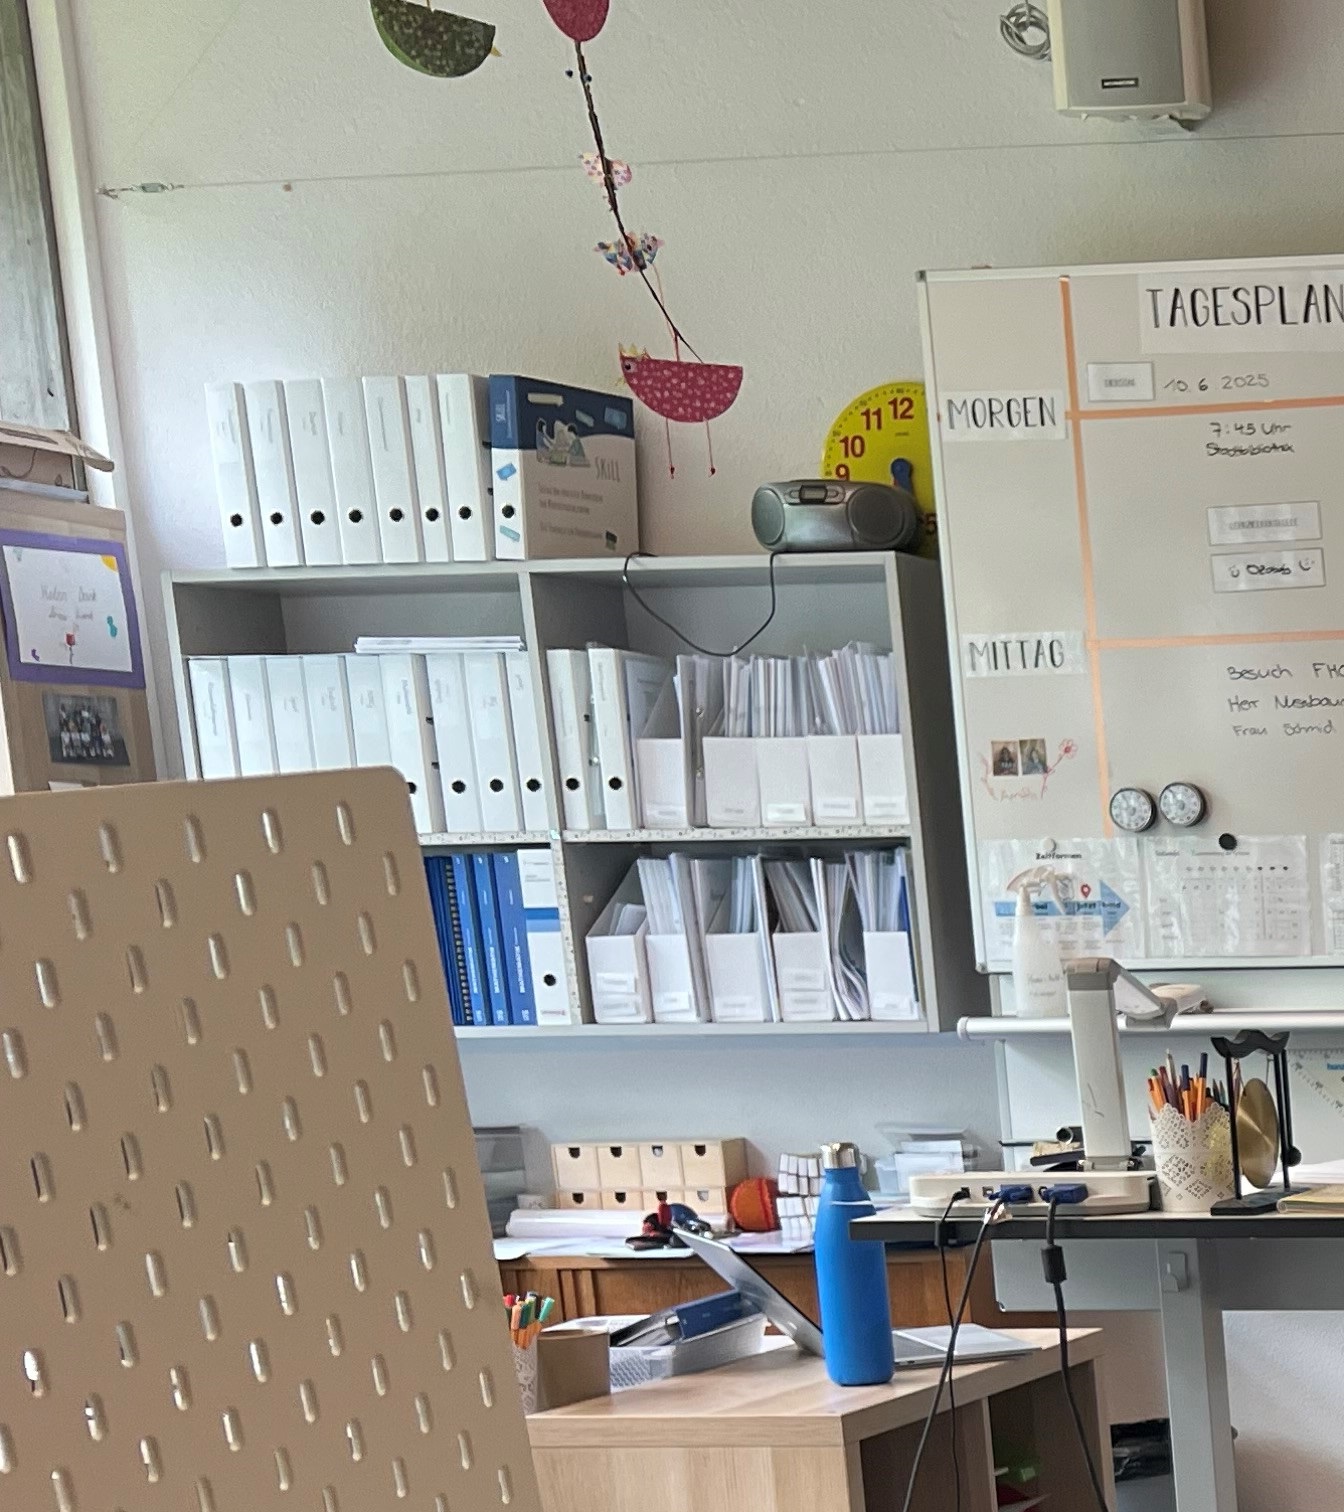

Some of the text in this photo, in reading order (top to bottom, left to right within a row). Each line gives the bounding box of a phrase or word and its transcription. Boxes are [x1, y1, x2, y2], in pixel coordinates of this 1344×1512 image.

[1221, 373, 1270, 390] 2025
[861, 408, 882, 430] 11
[889, 397, 914, 420] 12
[946, 397, 1057, 430] MORGEN
[839, 435, 865, 458] 10
[968, 639, 1066, 672] MITTAG
[1227, 664, 1293, 680] Besuch
